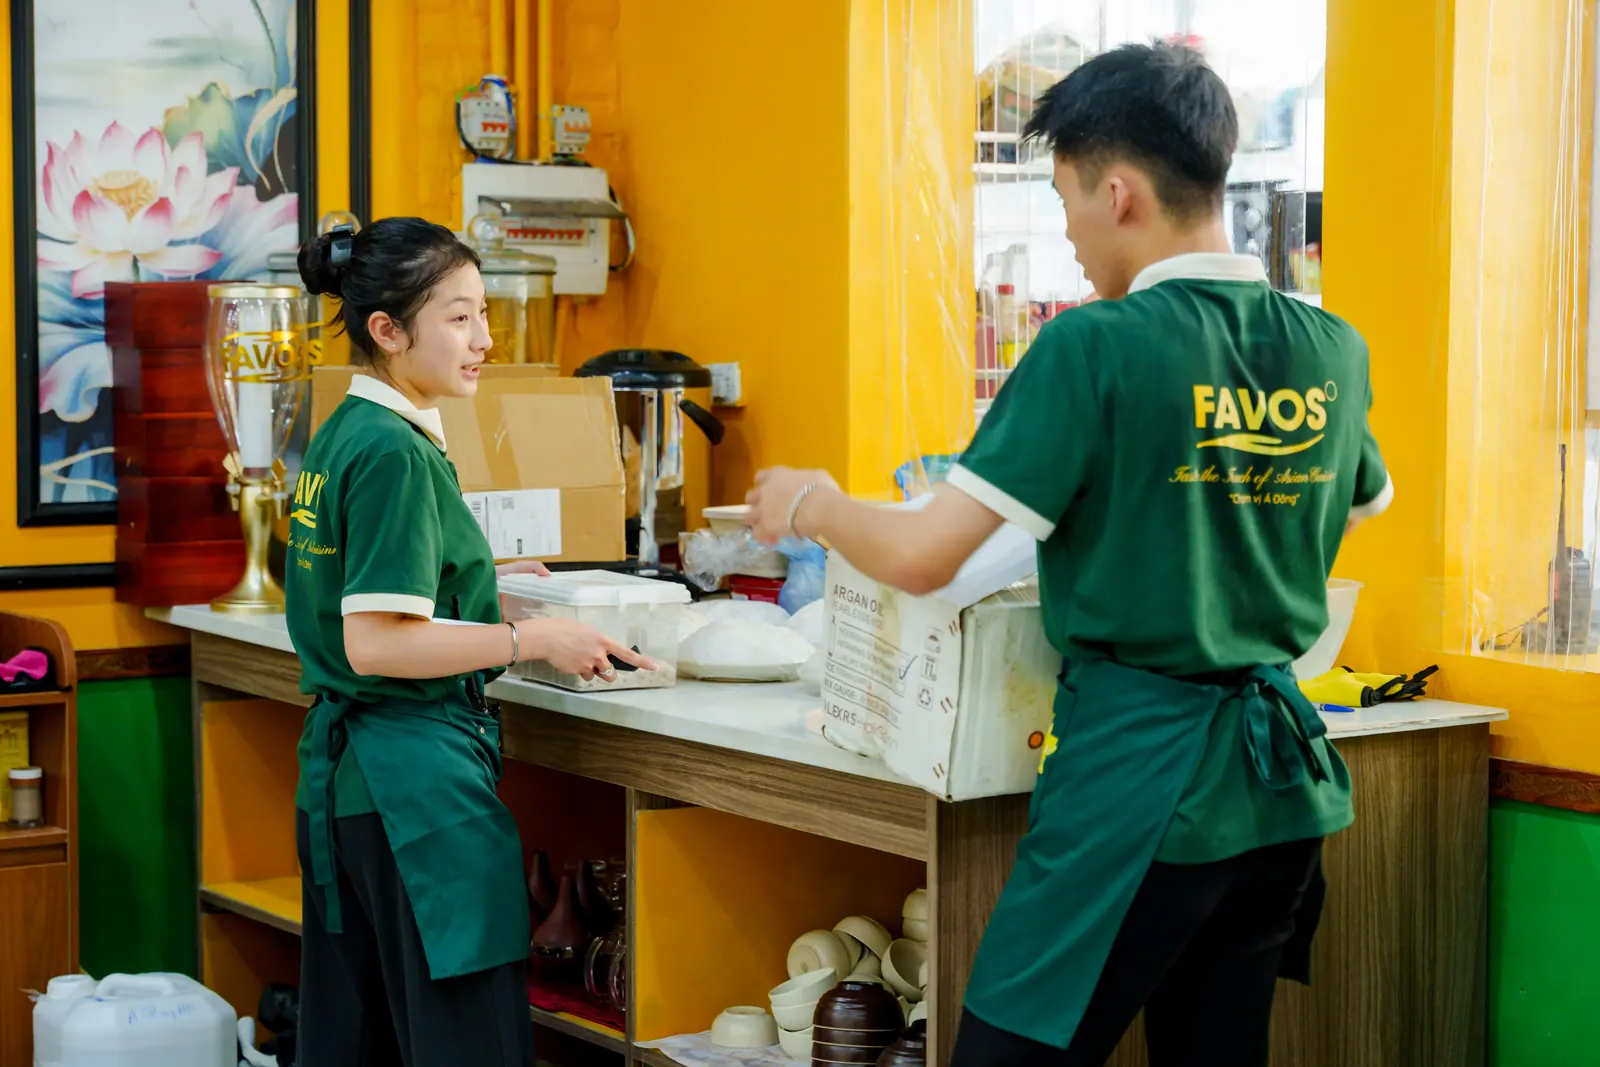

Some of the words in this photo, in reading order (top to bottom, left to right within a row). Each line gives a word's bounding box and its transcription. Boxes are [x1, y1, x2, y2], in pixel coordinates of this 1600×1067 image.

[1192, 384, 1328, 432] FAVOS
[1253, 465, 1275, 491] of
[832, 584, 869, 610] ARGAN
[870, 599, 884, 618] OIL
